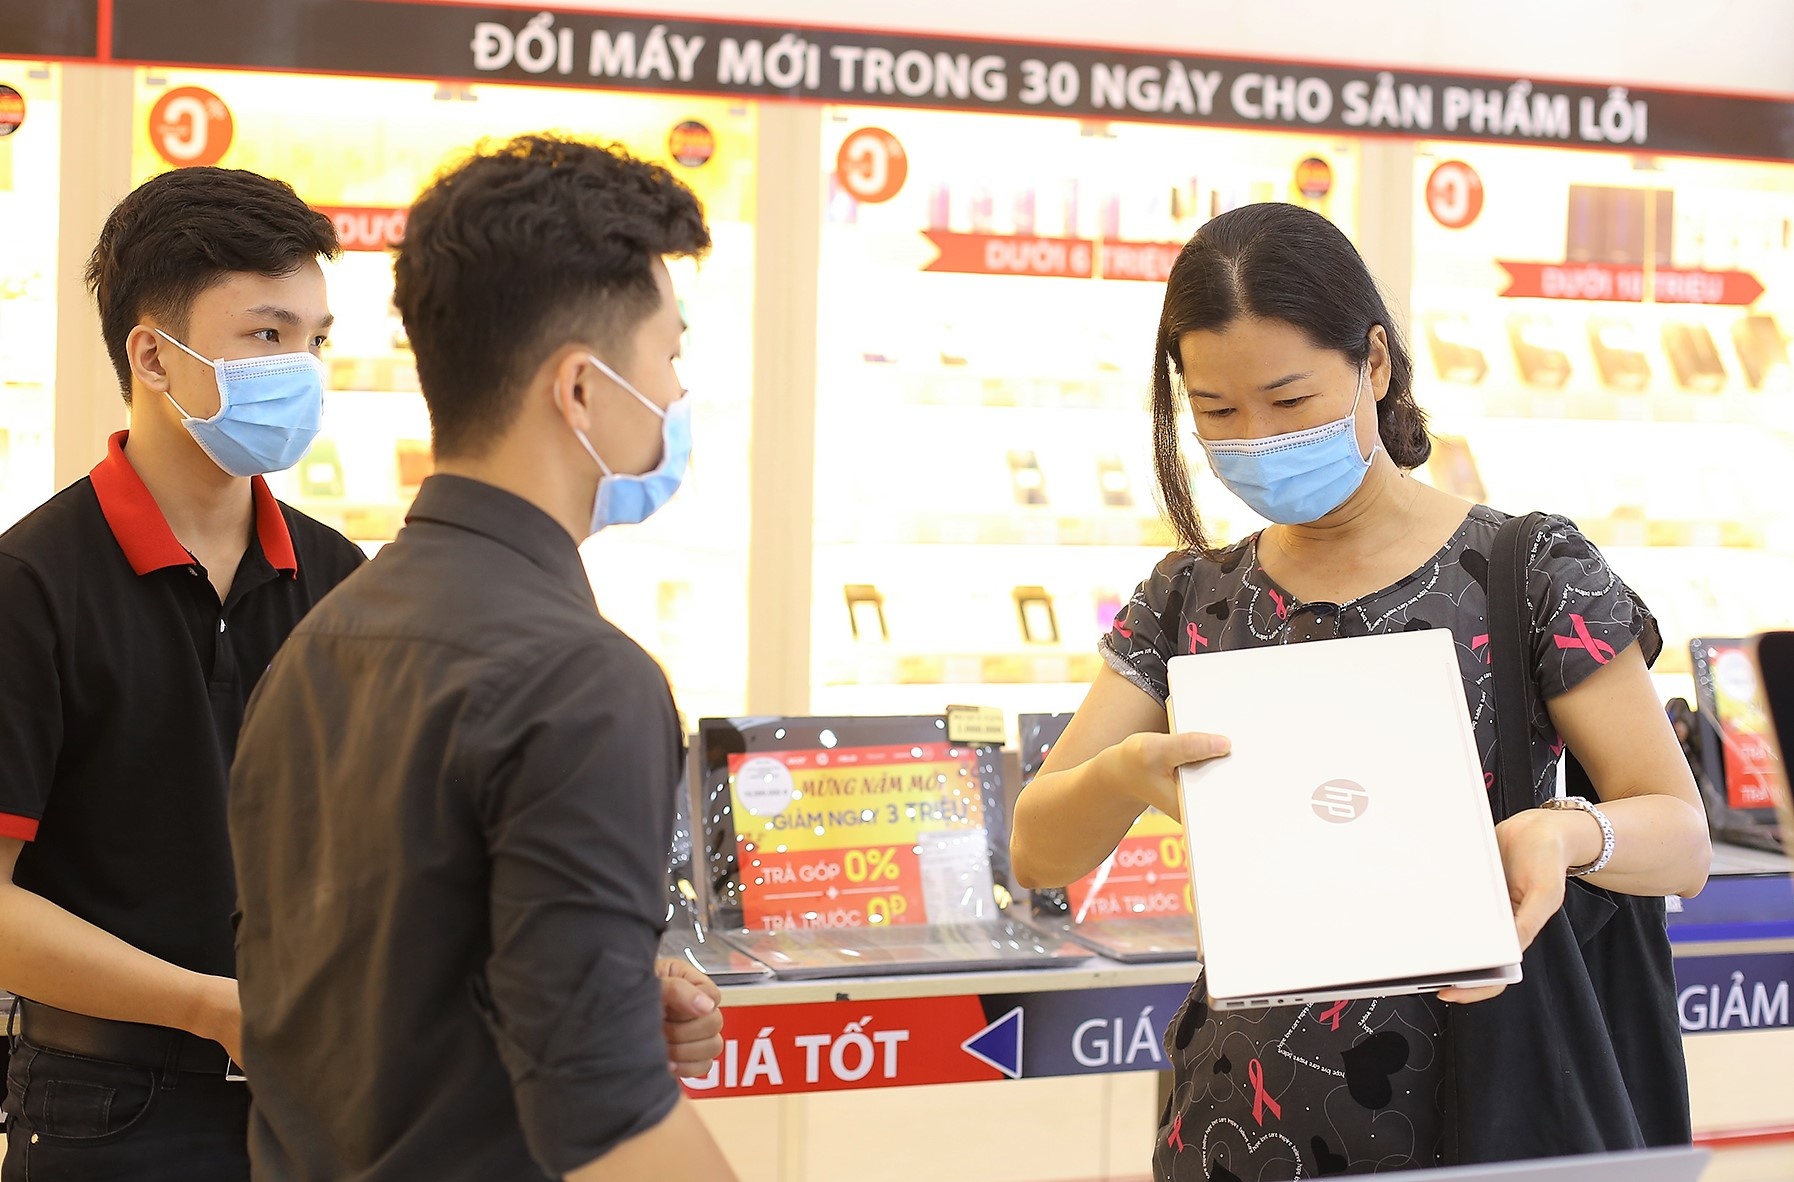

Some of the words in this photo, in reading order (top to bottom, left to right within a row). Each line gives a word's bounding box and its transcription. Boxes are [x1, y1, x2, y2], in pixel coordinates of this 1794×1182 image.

[470, 11, 574, 75] ĐỔI
[588, 25, 705, 82] MÁY
[717, 33, 821, 90] MỚI
[830, 45, 1007, 102] TRONG
[1018, 58, 1080, 107] 30
[1090, 59, 1222, 116] NGÀY
[1230, 72, 1333, 123] CHO
[1341, 70, 1433, 129] SẢN
[1443, 79, 1571, 139] PHẨM
[1579, 85, 1648, 144] LỖI
[985, 239, 1066, 273] DƯỚI
[886, 803, 899, 824] 3
[761, 861, 797, 884] TRẢ
[799, 858, 841, 883] GÓP
[844, 847, 900, 883] 0%
[1678, 970, 1789, 1031] GIẢM
[795, 1015, 909, 1083] TỐT
[1072, 1005, 1161, 1067] GIÁ
